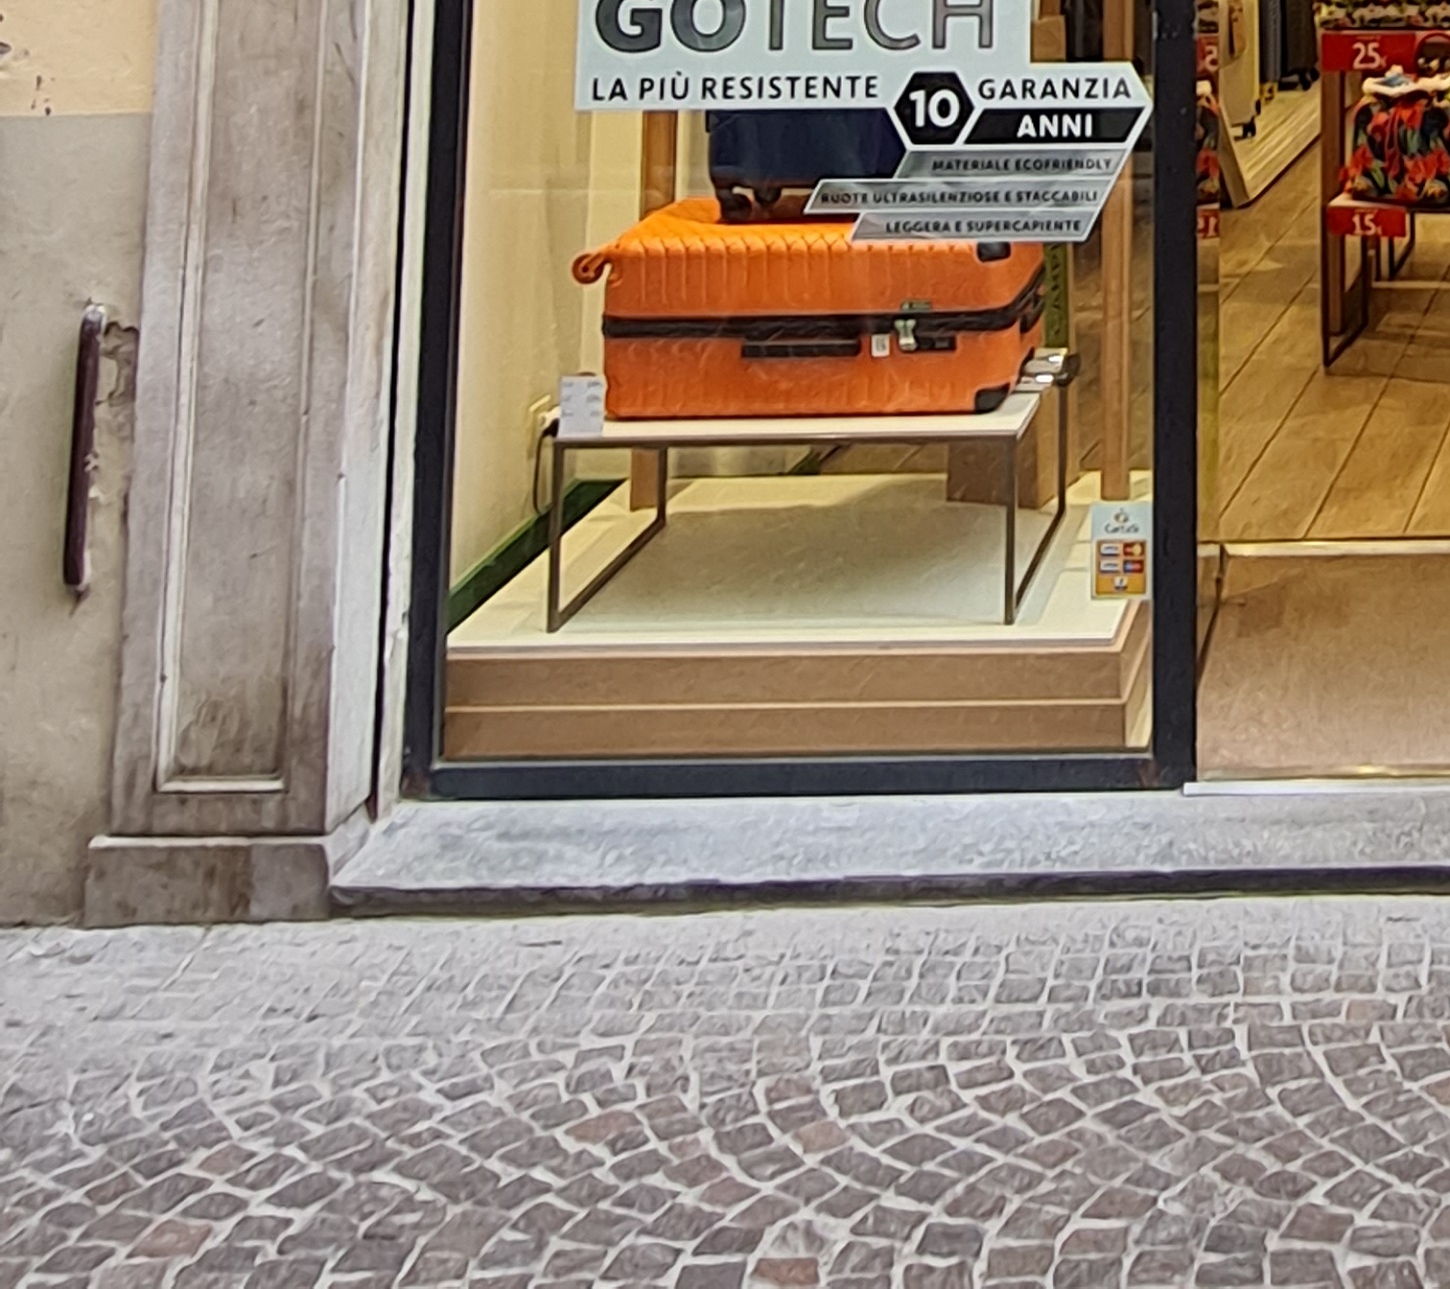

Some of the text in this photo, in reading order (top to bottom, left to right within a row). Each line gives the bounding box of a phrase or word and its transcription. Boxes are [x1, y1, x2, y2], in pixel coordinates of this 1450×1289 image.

[592, 71, 878, 101] LA PIÙ RESISTENTE
[978, 77, 1131, 100] GARANZIA
[908, 89, 960, 128] 10
[1017, 114, 1093, 138] ANNI
[932, 158, 1112, 171] MATERIALE ECOFRIENDLY
[821, 189, 1097, 205] RUOTE ULTRASILENZIOSE E STACCABILI
[886, 219, 1081, 233] LEGGERA E SUPERCAPIENTE
